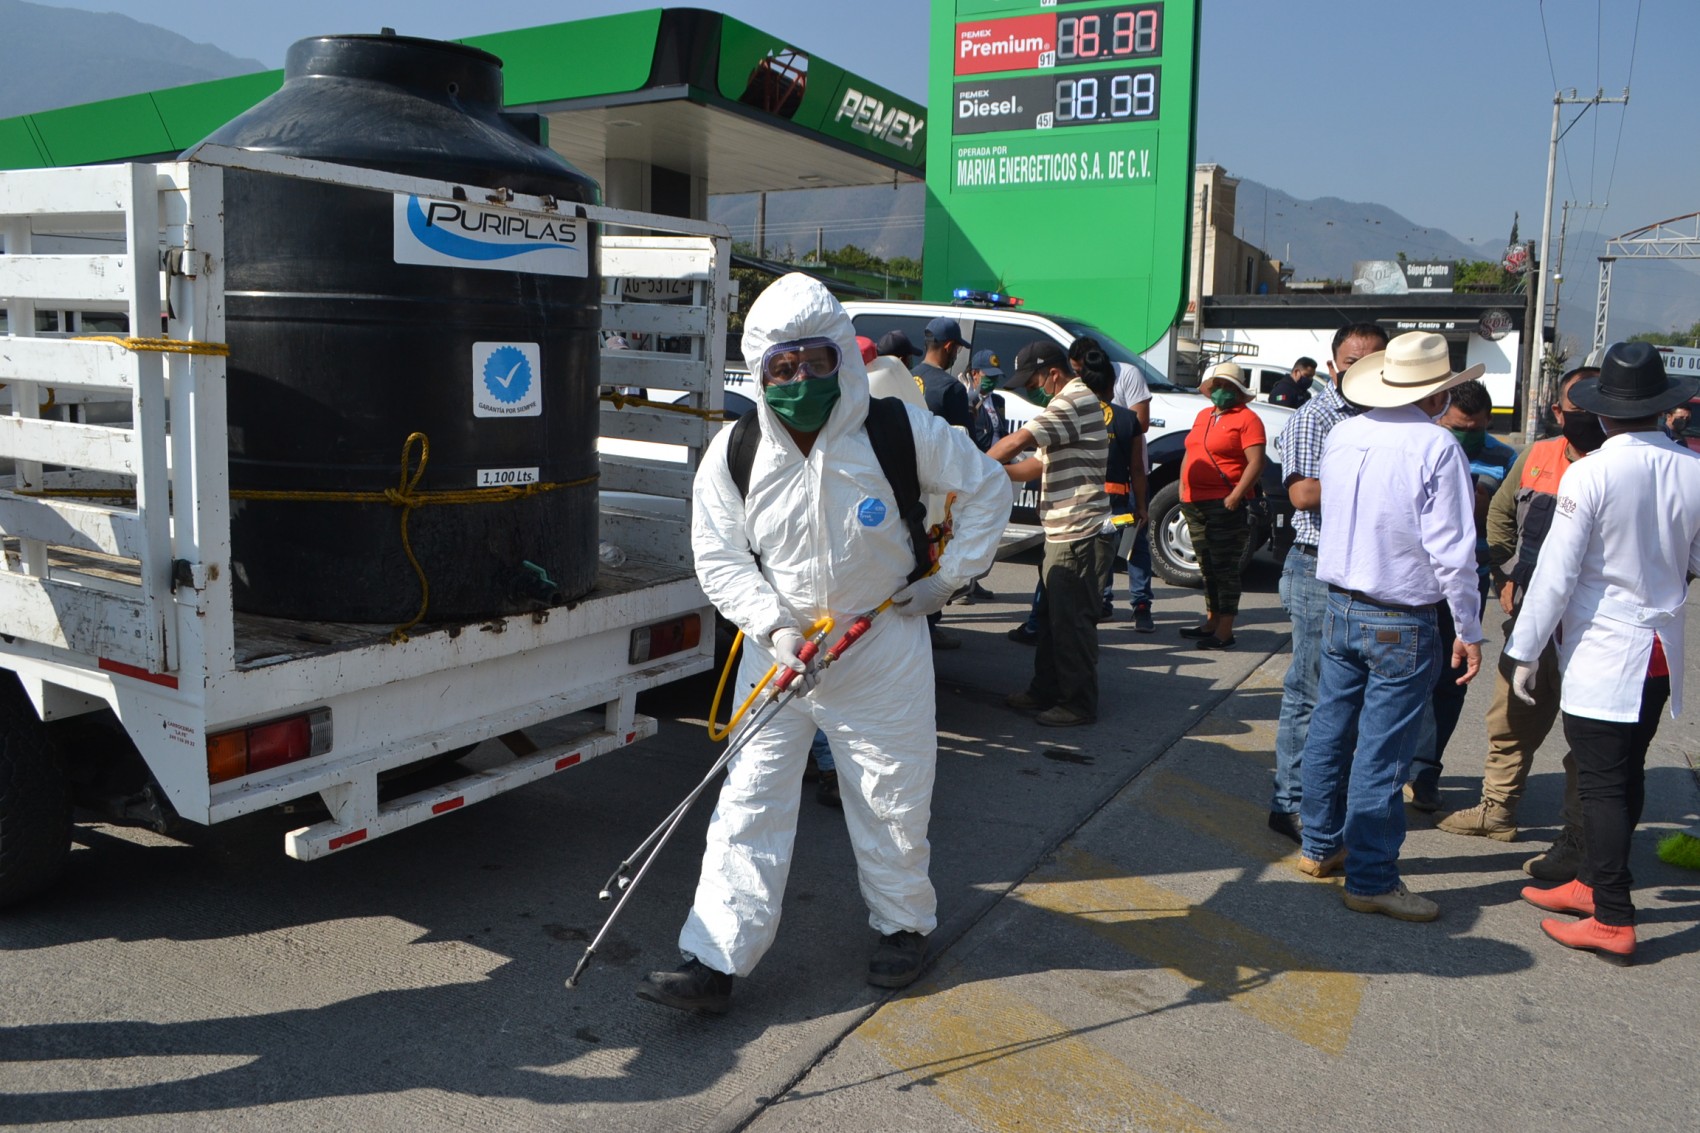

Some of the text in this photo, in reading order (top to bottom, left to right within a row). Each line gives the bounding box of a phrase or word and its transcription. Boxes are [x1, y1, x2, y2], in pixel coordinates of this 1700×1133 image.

[961, 29, 992, 39] PEMEX
[1073, 10, 1157, 57] 16.37
[961, 35, 1043, 58] Premium
[959, 90, 990, 99] PEMEX
[1071, 73, 1154, 119] 18.59
[959, 96, 1016, 118] Diesel
[835, 87, 925, 151] PEMEX
[958, 146, 1007, 158] OPERADA POR
[957, 149, 1151, 186] MARVA ENERGETICOS S.A. DE C.V.
[426, 202, 576, 243] PURIPLAS
[1427, 264, 1449, 276] Centro
[1423, 276, 1432, 287] AC
[1397, 321, 1416, 329] Super
[517, 401, 537, 413] SIEMPRE
[483, 471, 535, 485] 1,100 Lts.
